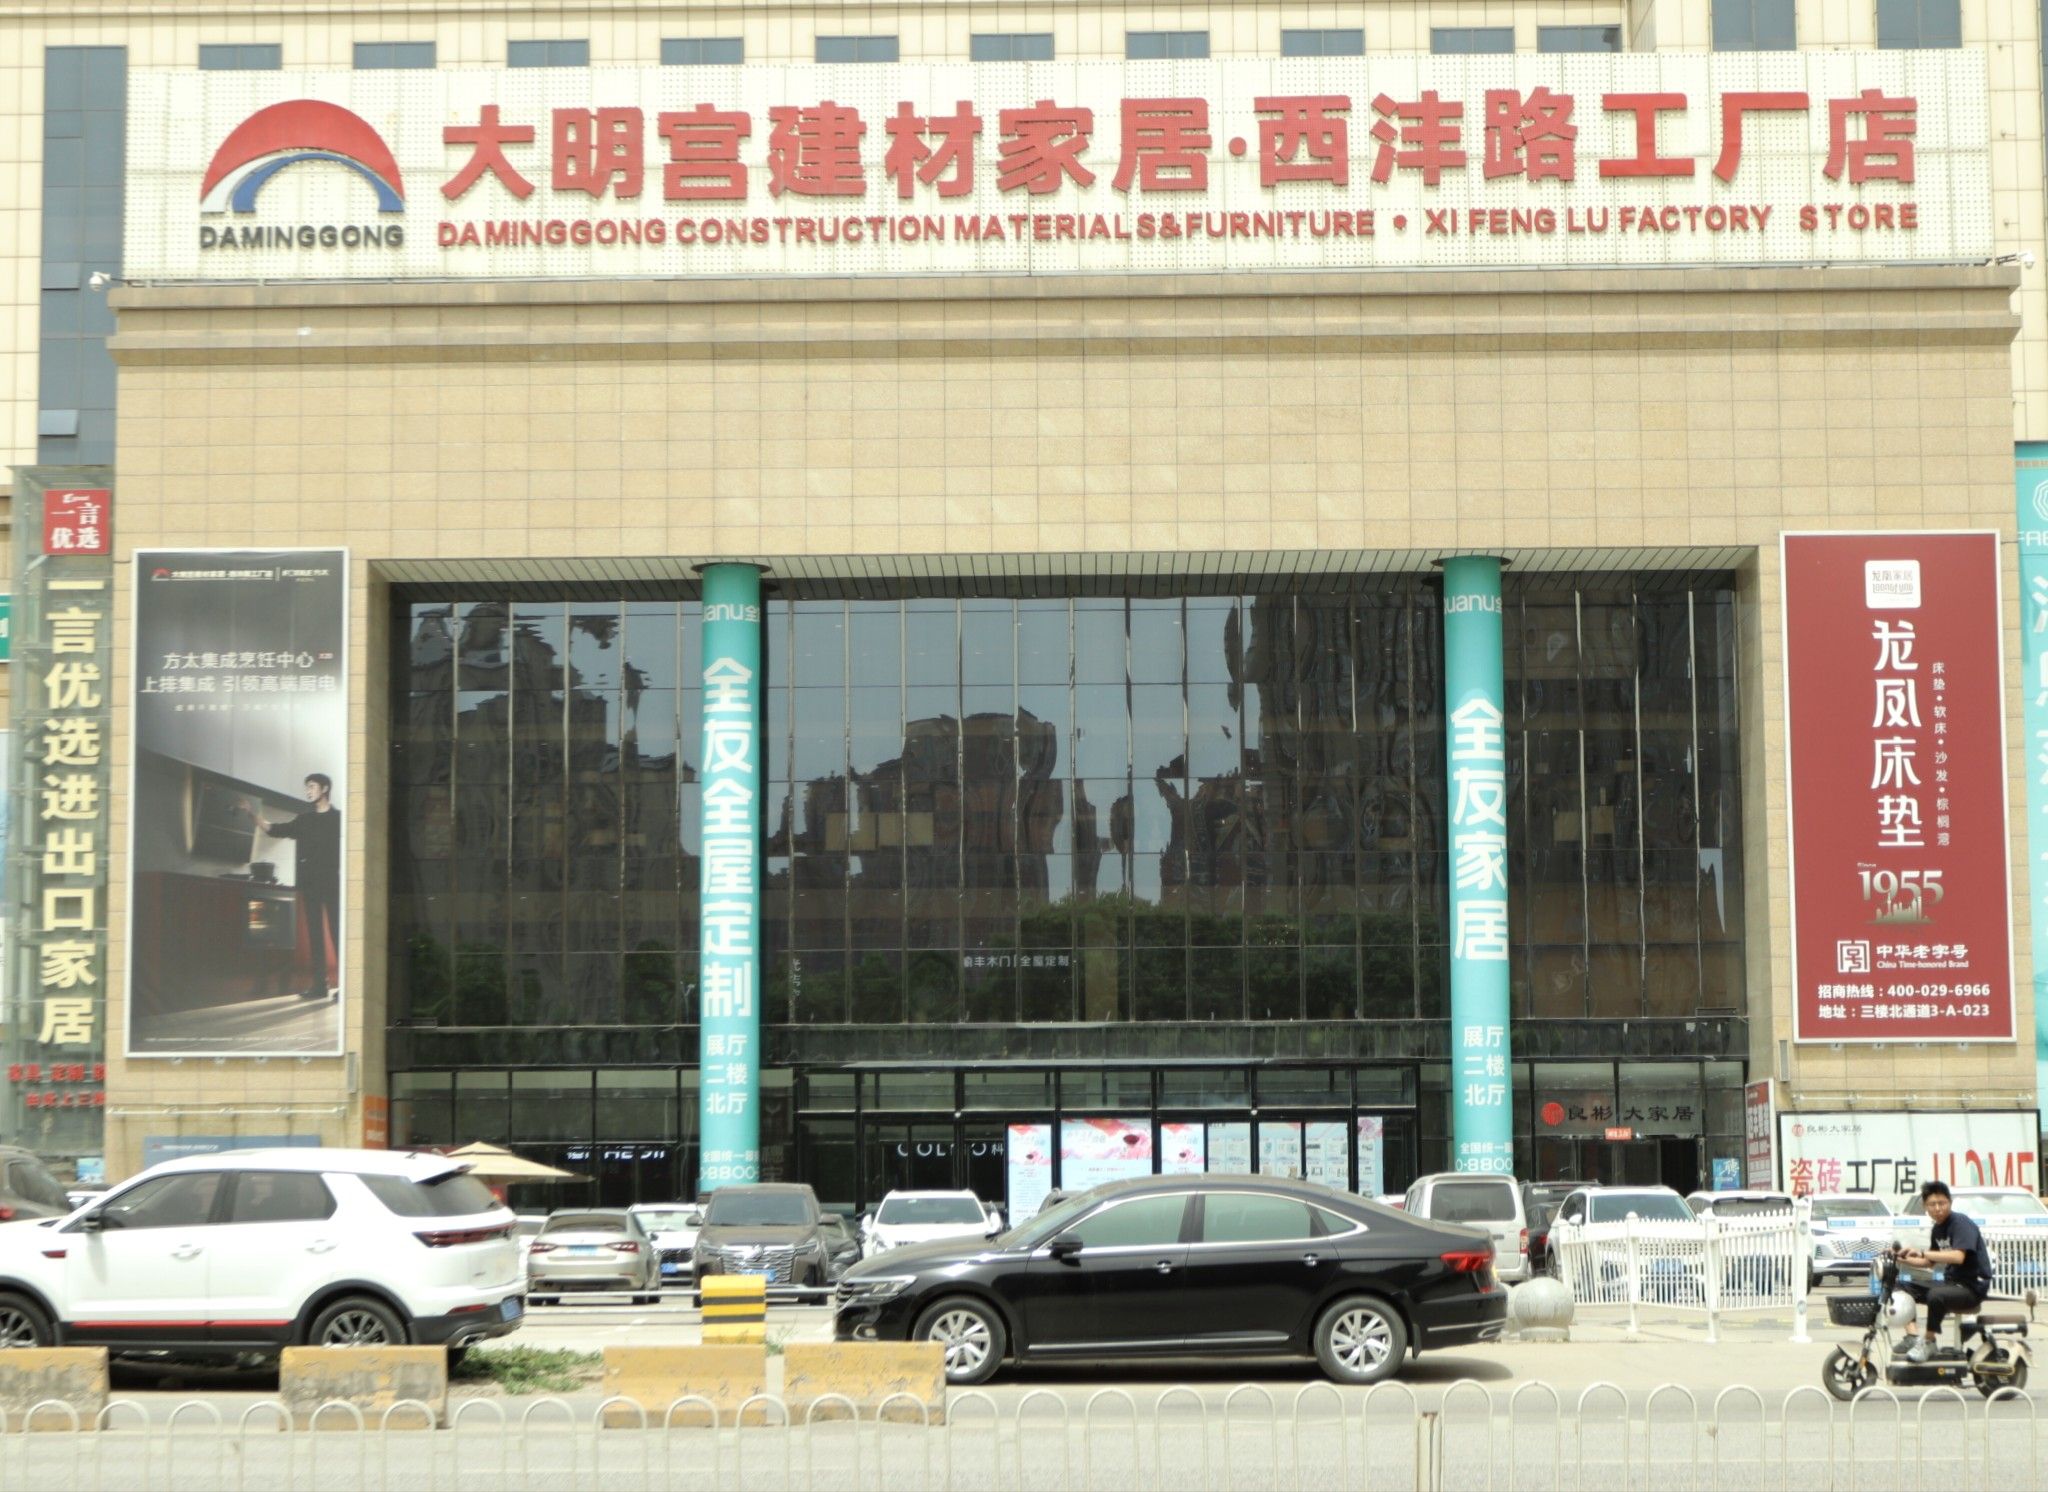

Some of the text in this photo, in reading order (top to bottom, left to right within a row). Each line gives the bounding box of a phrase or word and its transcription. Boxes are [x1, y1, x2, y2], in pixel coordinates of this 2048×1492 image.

[199, 224, 404, 249] DAMINGGONG
[438, 219, 666, 248] DAMINGGONG
[676, 215, 944, 245] CONSTRUCTION
[1426, 208, 1457, 234] XI
[1469, 208, 1556, 234] FENG
[1568, 207, 1609, 232] LU
[1619, 205, 1772, 234] FACTORY
[1800, 203, 1918, 231] STORE
[51, 526, 100, 549] 优选
[162, 651, 315, 670] 方太集成烹饪中心
[139, 675, 216, 693] 上排集成
[1870, 619, 1926, 847] 龙凤床垫
[39, 580, 104, 1045] 一言优选进出口家居
[702, 656, 754, 1018] 全友全屋定制
[1450, 698, 1509, 960] 全友家居
[1857, 870, 1945, 905] 1955
[1876, 944, 1969, 959] 中华老字号
[706, 1034, 748, 1057] 展厅
[1463, 1025, 1504, 1048] 展厅
[706, 1062, 748, 1086] 二楼
[1463, 1054, 1505, 1077] 二楼
[706, 1092, 748, 1115] 北厅
[1464, 1083, 1506, 1107] 北厅
[1568, 1105, 1695, 1122] 良彬大家居
